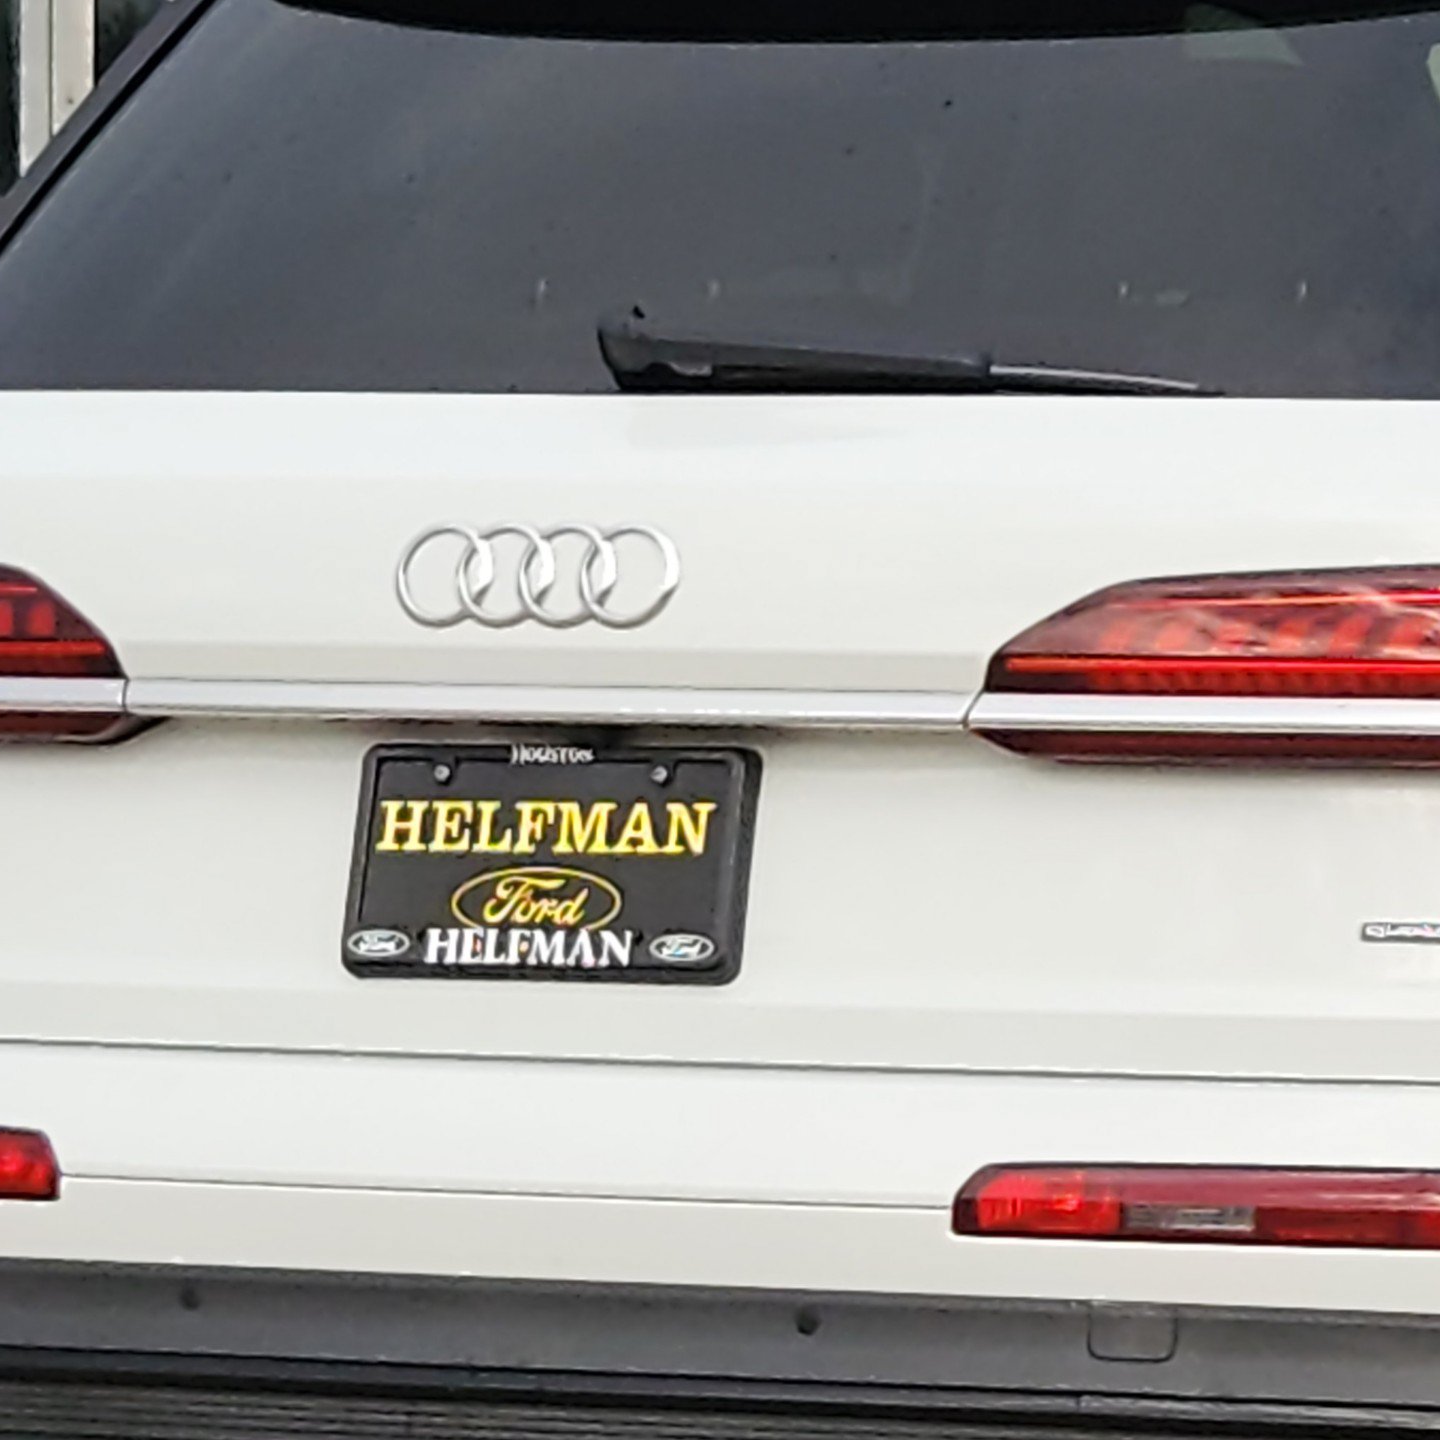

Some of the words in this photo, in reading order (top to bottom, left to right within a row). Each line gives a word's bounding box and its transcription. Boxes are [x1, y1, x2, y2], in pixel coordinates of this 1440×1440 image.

[375, 799, 717, 856] HELFMAN
[482, 875, 590, 926] Ford
[423, 927, 634, 967] HELFMAN
